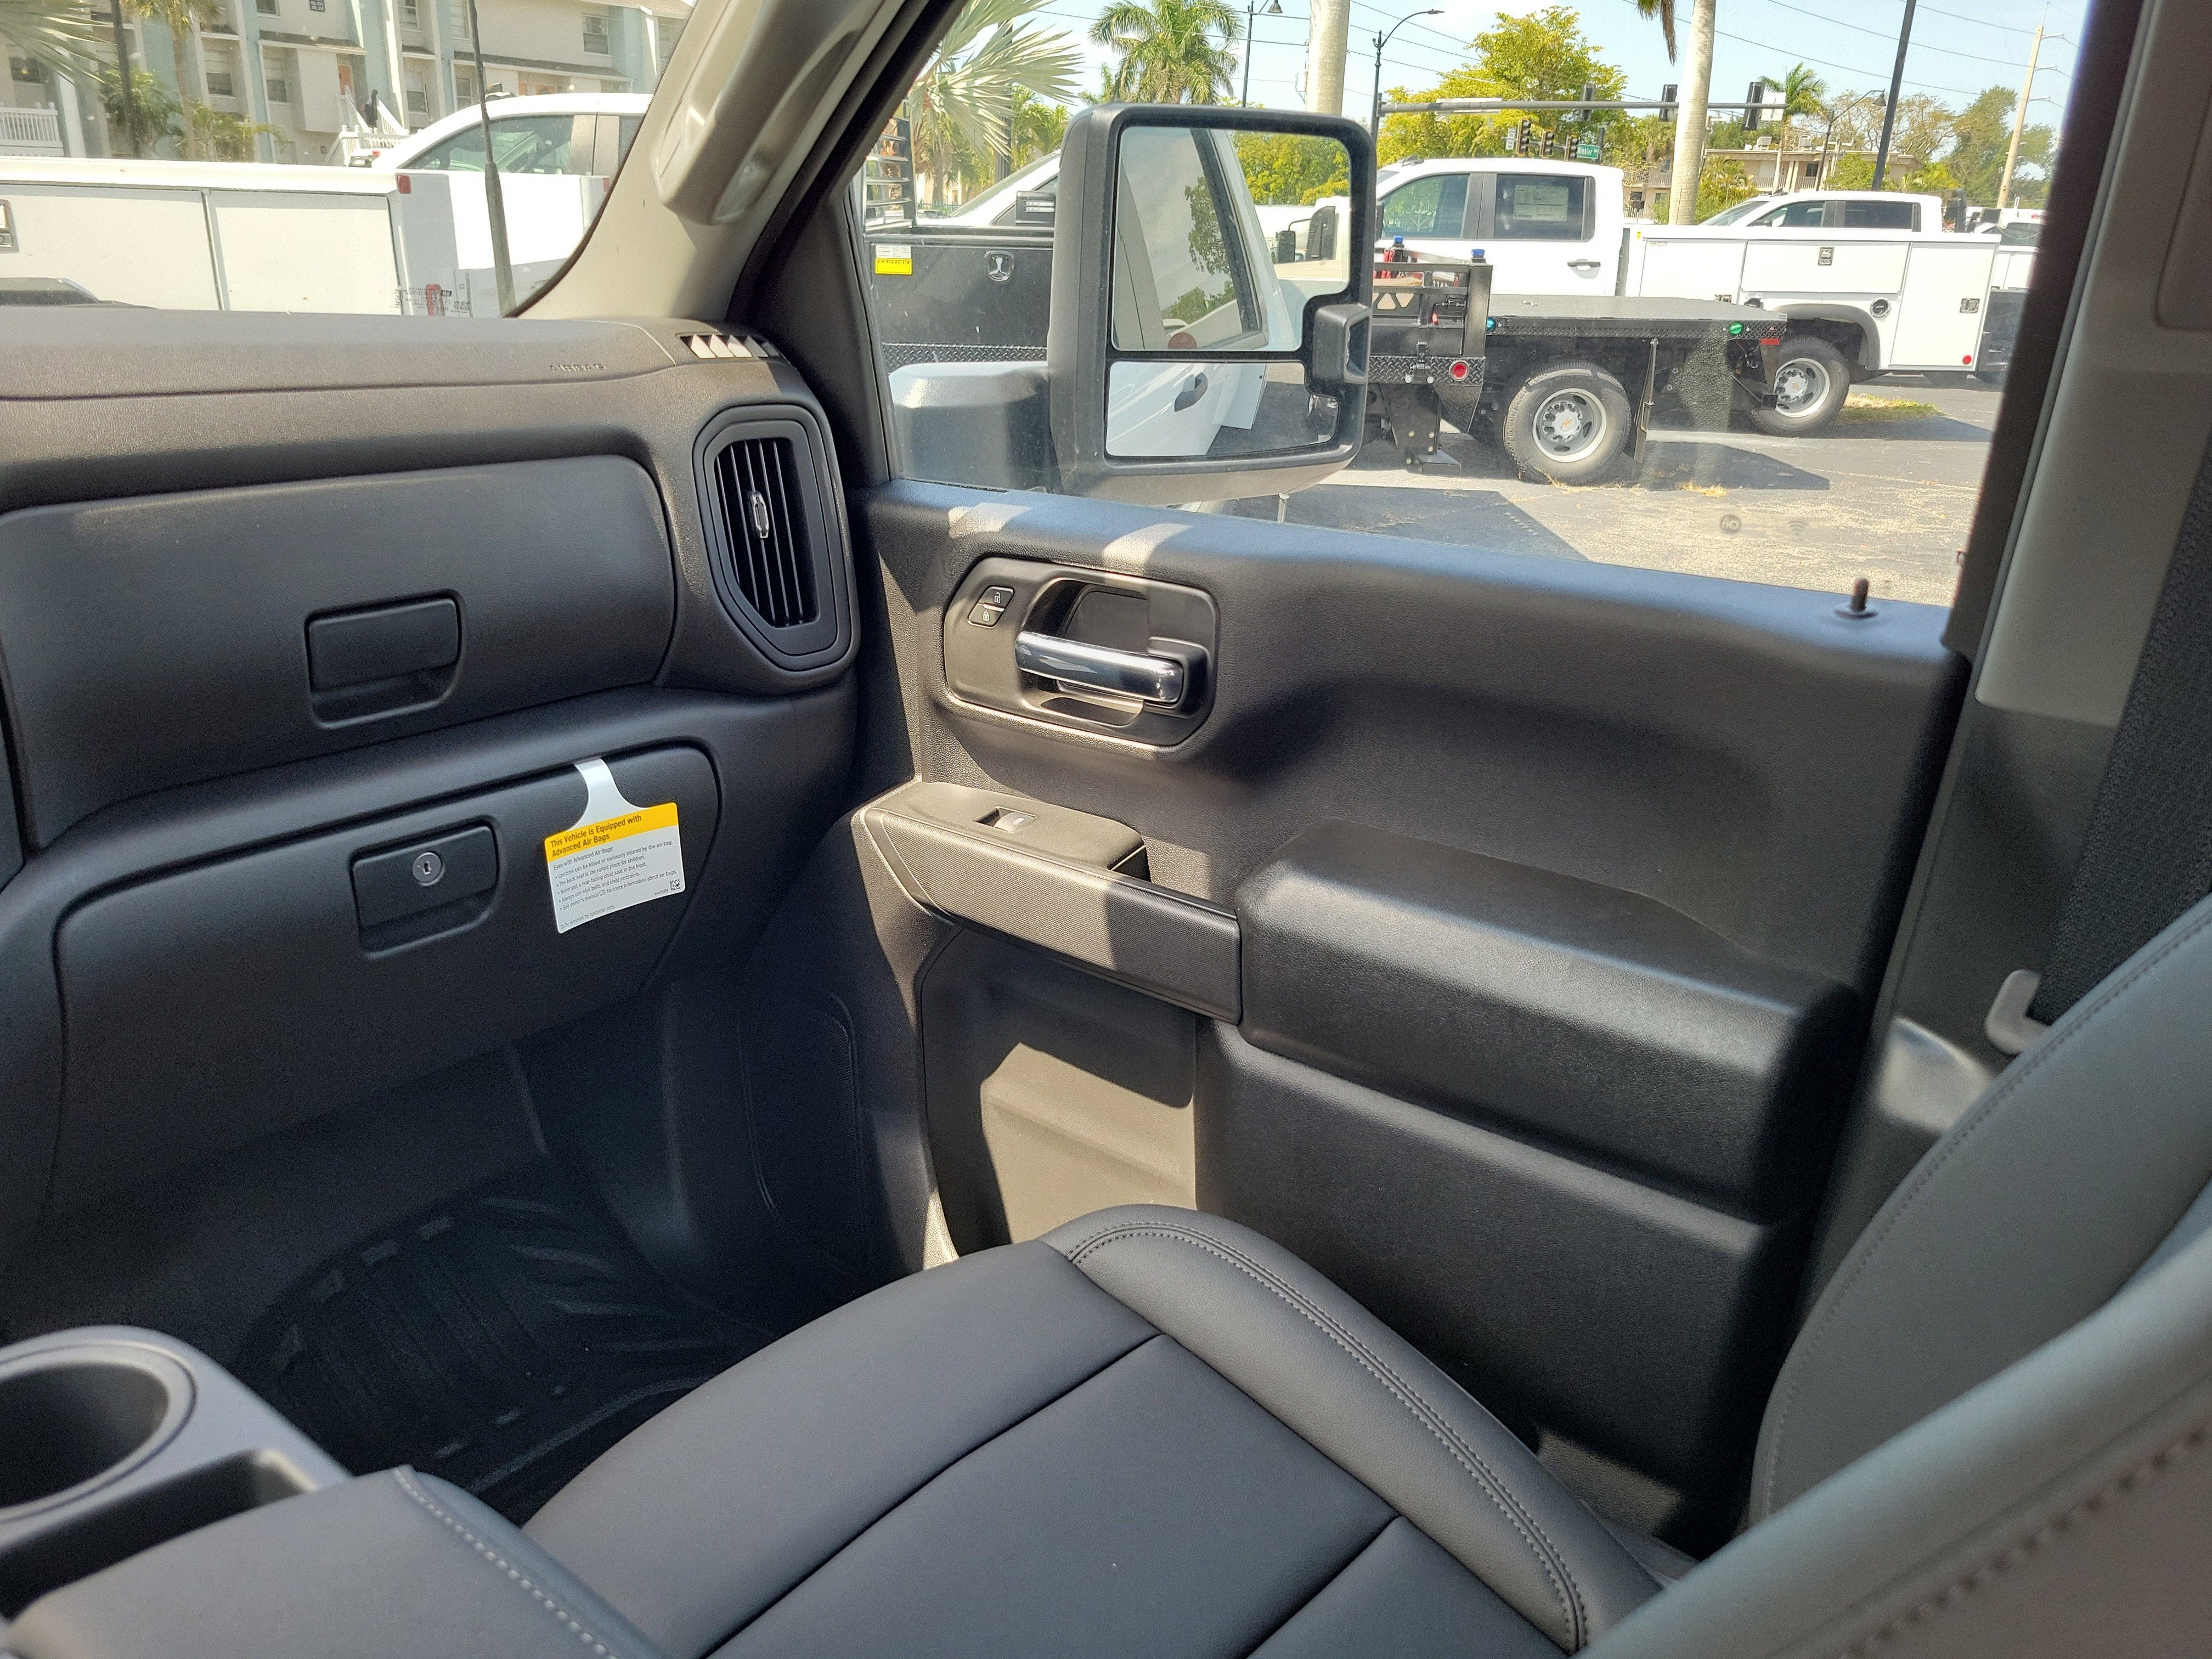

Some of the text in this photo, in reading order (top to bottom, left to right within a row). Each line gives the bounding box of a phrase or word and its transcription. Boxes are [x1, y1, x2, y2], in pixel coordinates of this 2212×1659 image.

[550, 363, 606, 372] AIRBAG
[551, 838, 563, 848] This
[564, 831, 587, 843] Vehicle
[596, 819, 625, 833] Equipped
[628, 815, 642, 824] with
[552, 833, 610, 857] Advanced Air Bags
[558, 869, 574, 878] Children
[607, 852, 625, 862] seriously
[627, 848, 641, 856] injured
[573, 852, 594, 863] Advanced
[628, 855, 645, 864] children.
[562, 894, 574, 902] Always
[585, 893, 599, 901] manual
[624, 878, 646, 888] information
[569, 915, 584, 924] removed
[589, 907, 606, 917] customer
